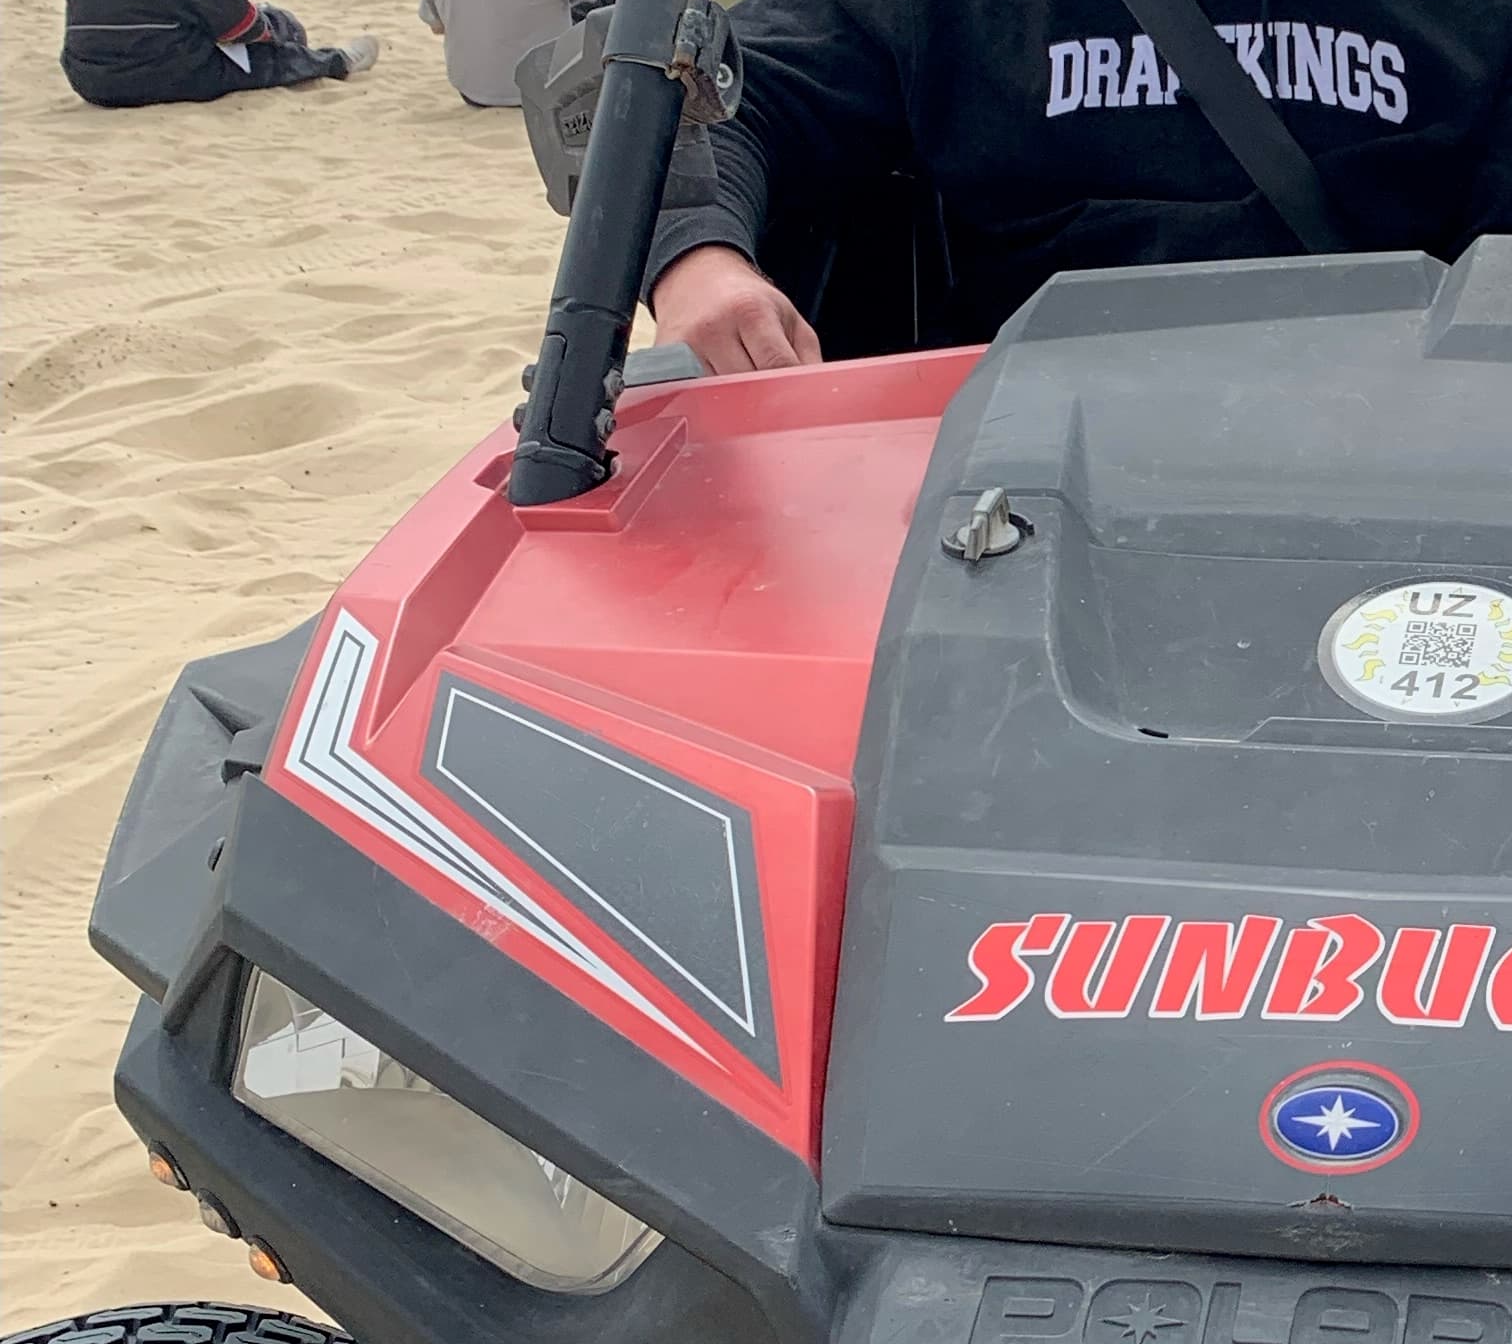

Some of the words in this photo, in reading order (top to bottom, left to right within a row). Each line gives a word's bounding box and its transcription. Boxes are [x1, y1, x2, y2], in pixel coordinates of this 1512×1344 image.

[1045, 21, 1409, 125] DRAKINGS
[1409, 591, 1477, 618] UZ
[1390, 670, 1481, 701] 412
